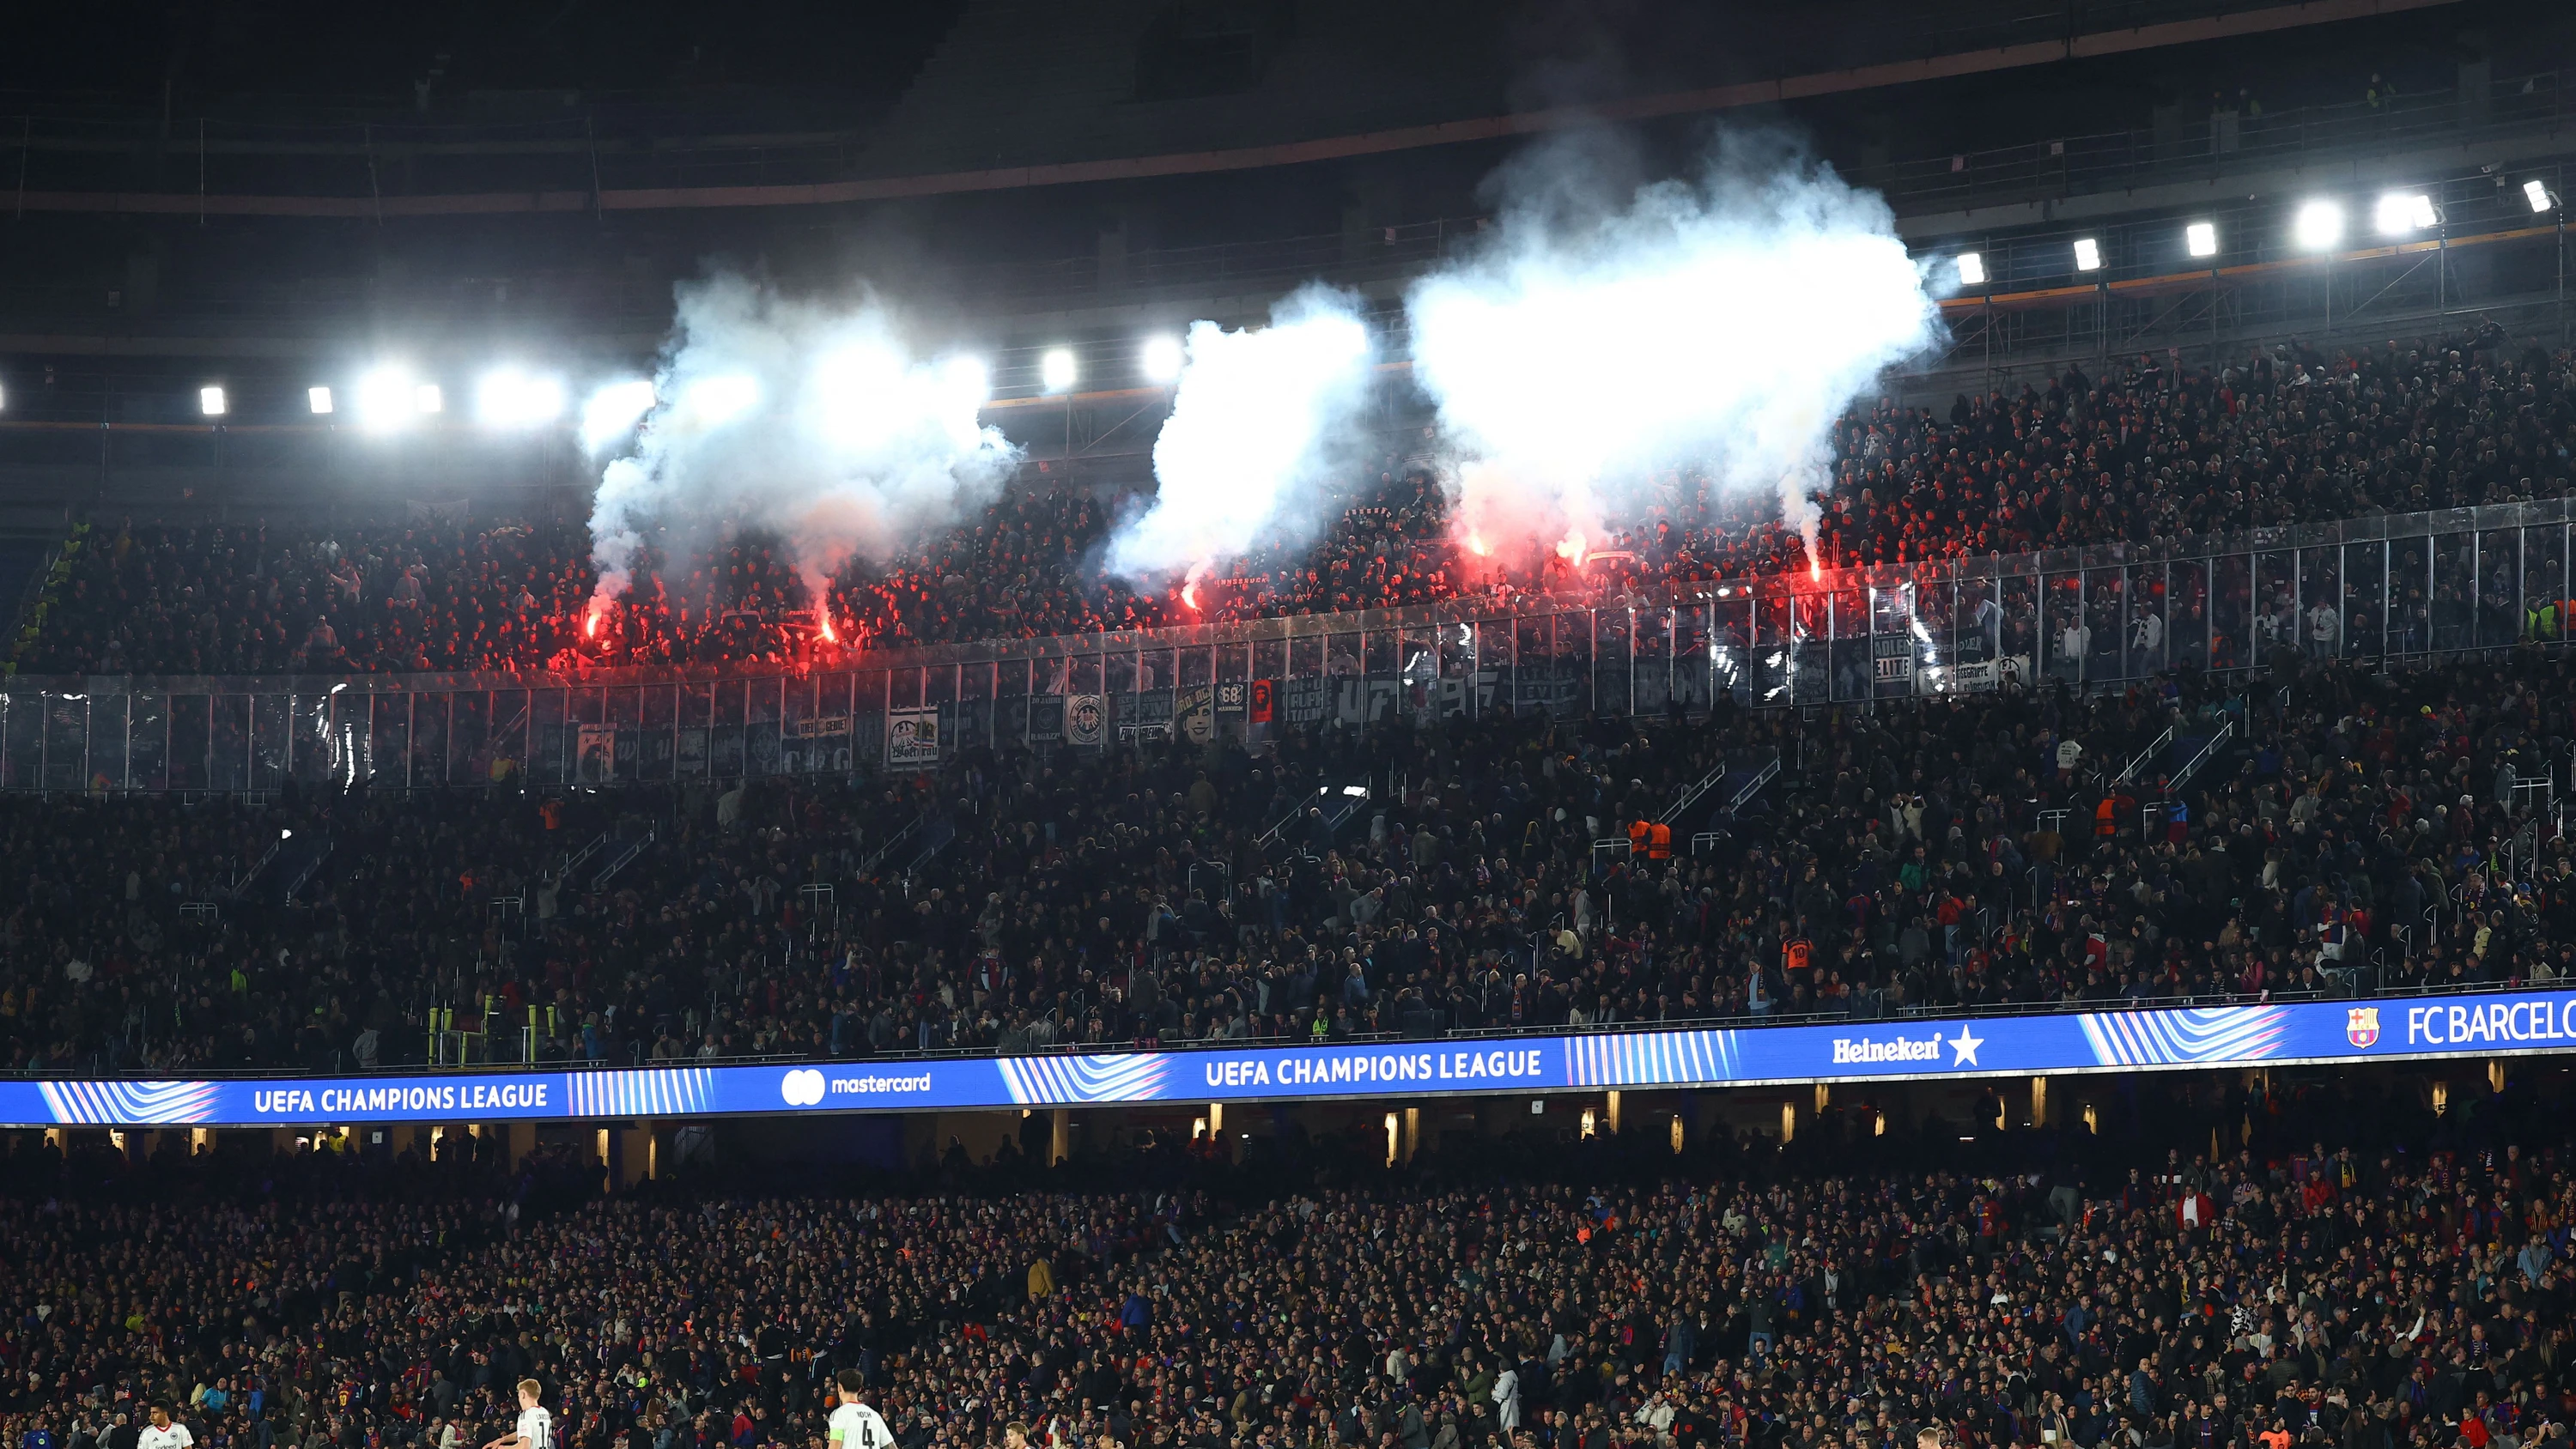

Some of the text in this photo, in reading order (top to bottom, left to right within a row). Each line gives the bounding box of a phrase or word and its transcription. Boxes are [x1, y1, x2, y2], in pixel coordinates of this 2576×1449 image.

[1875, 658, 1909, 676] ELITE
[1222, 687, 1238, 702] 68
[1793, 947, 1805, 959] 10
[2409, 1007, 2444, 1045] FC
[1833, 1037, 1940, 1064] Heineken
[1206, 1050, 1541, 1087] UEFA CHAMPIONS LEAGUE
[832, 1072, 931, 1094] mastercard
[255, 1083, 548, 1113] UEFA CHAMPIONS LEAGUE
[863, 1420, 874, 1449] 4
